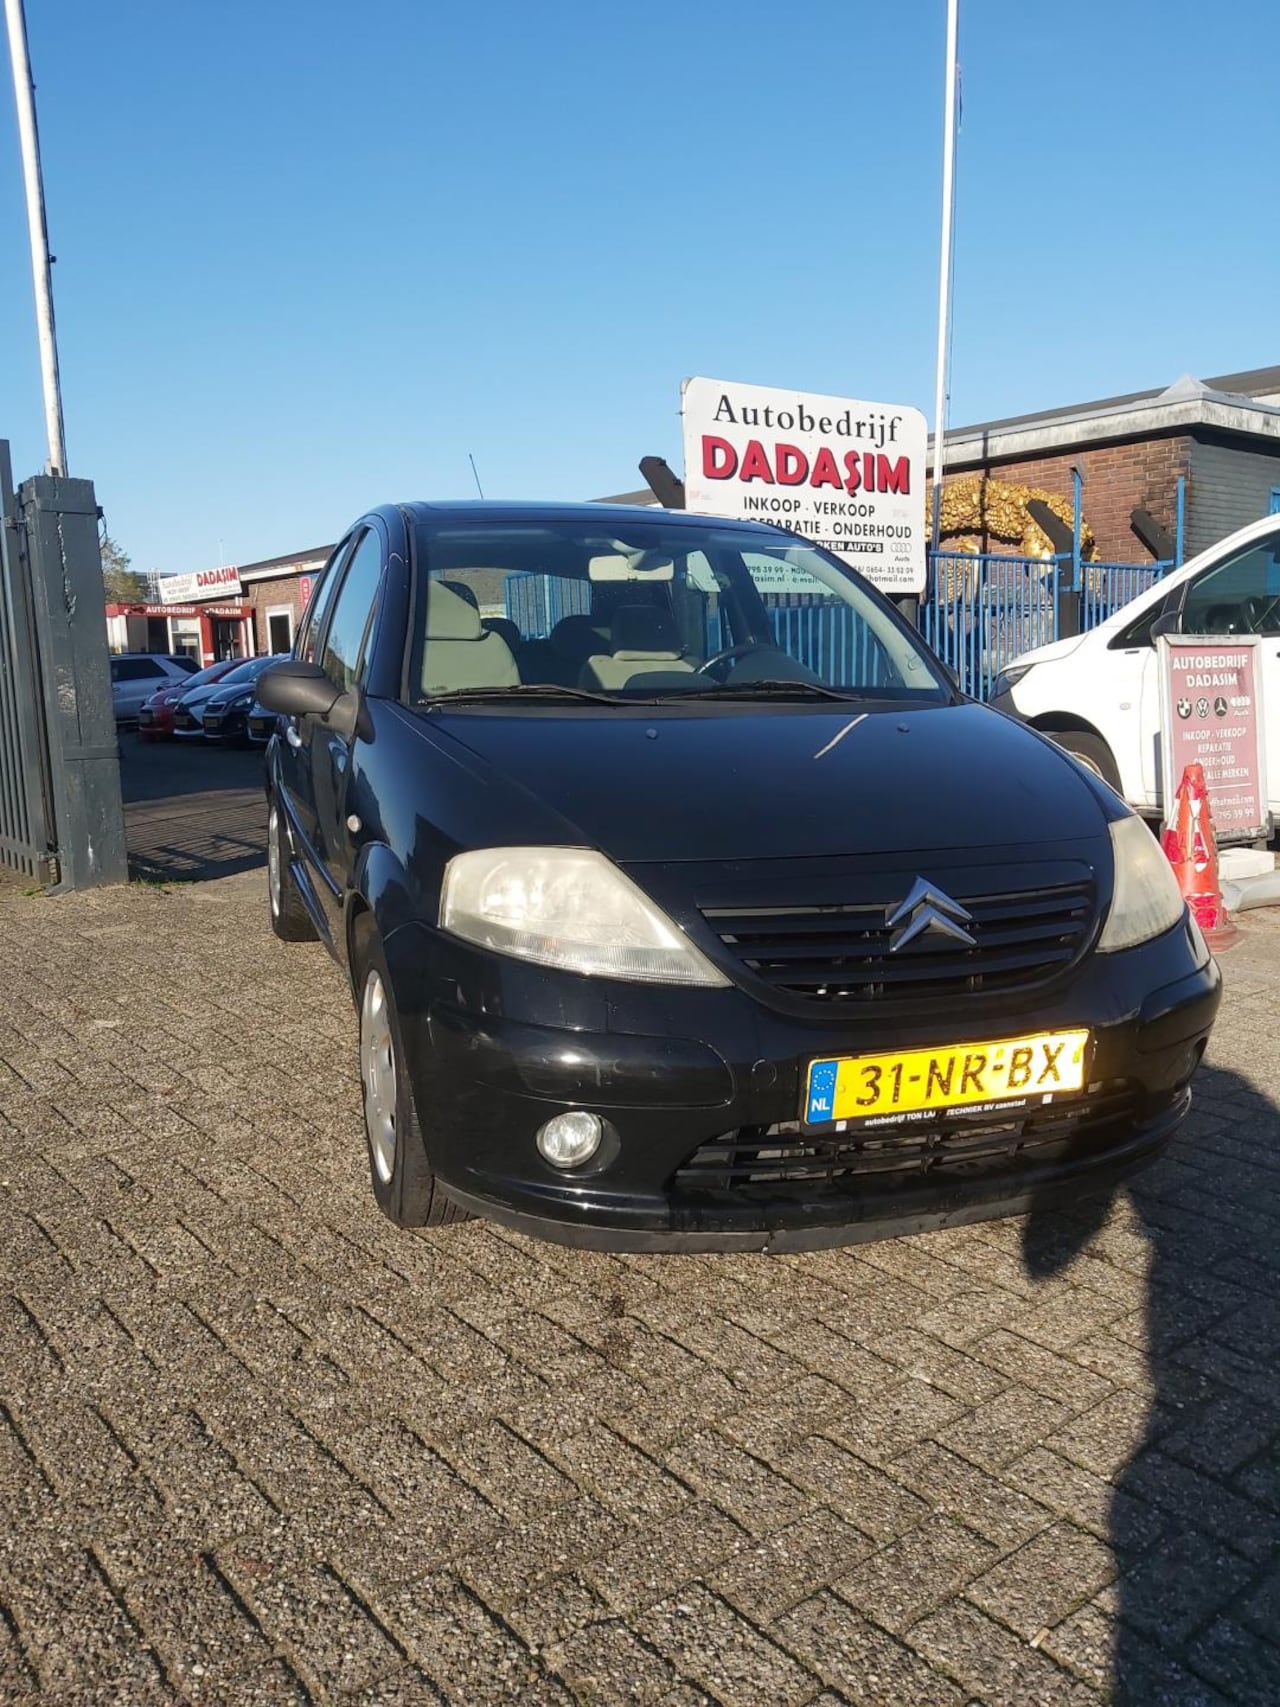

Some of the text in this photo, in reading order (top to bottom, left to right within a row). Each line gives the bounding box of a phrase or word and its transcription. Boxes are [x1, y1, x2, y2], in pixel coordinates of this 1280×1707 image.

[713, 394, 902, 448] Autobedrijf
[702, 435, 911, 498] DADAŞIM
[744, 496, 875, 518] INKOOP VERKOOP
[750, 517, 912, 539] PARATIE ONDERHOUD
[847, 542, 882, 552] AUTO'S
[146, 606, 196, 615] AUTOBEDRIJF
[1172, 654, 1249, 670] AUTOBEDRIJF
[1186, 672, 1238, 688] DADASIM
[1182, 727, 1247, 740] INKOOP VERKOOP
[856, 1042, 1066, 1106] 31-NR-BX
[811, 1098, 830, 1111] NL
[864, 1113, 904, 1126] autobedrijf
[906, 1112, 922, 1121] TON
